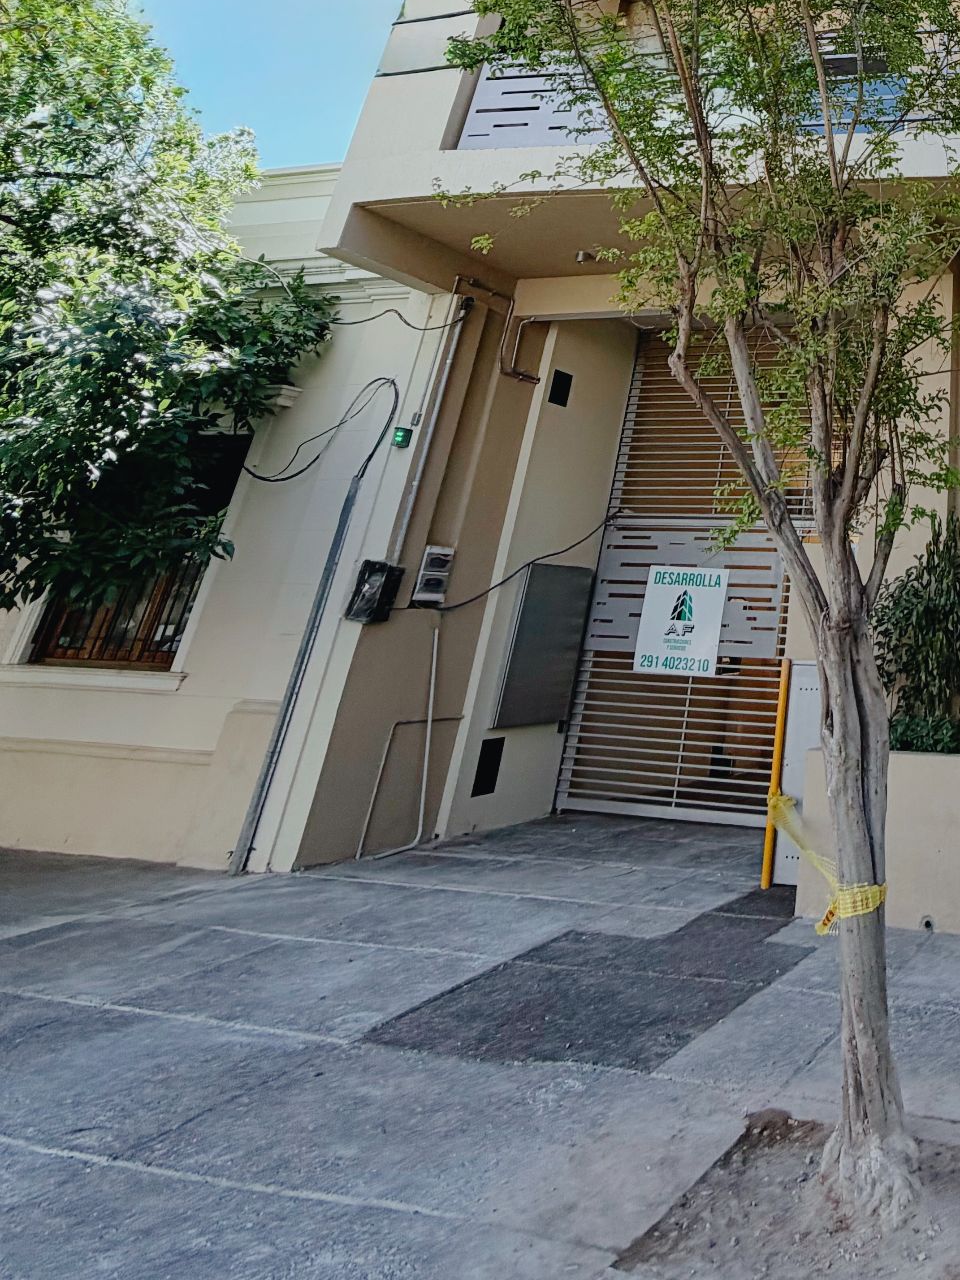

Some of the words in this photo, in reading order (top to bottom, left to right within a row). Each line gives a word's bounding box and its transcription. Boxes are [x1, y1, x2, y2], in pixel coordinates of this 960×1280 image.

[653, 571, 721, 588] DESARROLLA
[640, 654, 659, 669] 291
[662, 656, 710, 672] 4023210
